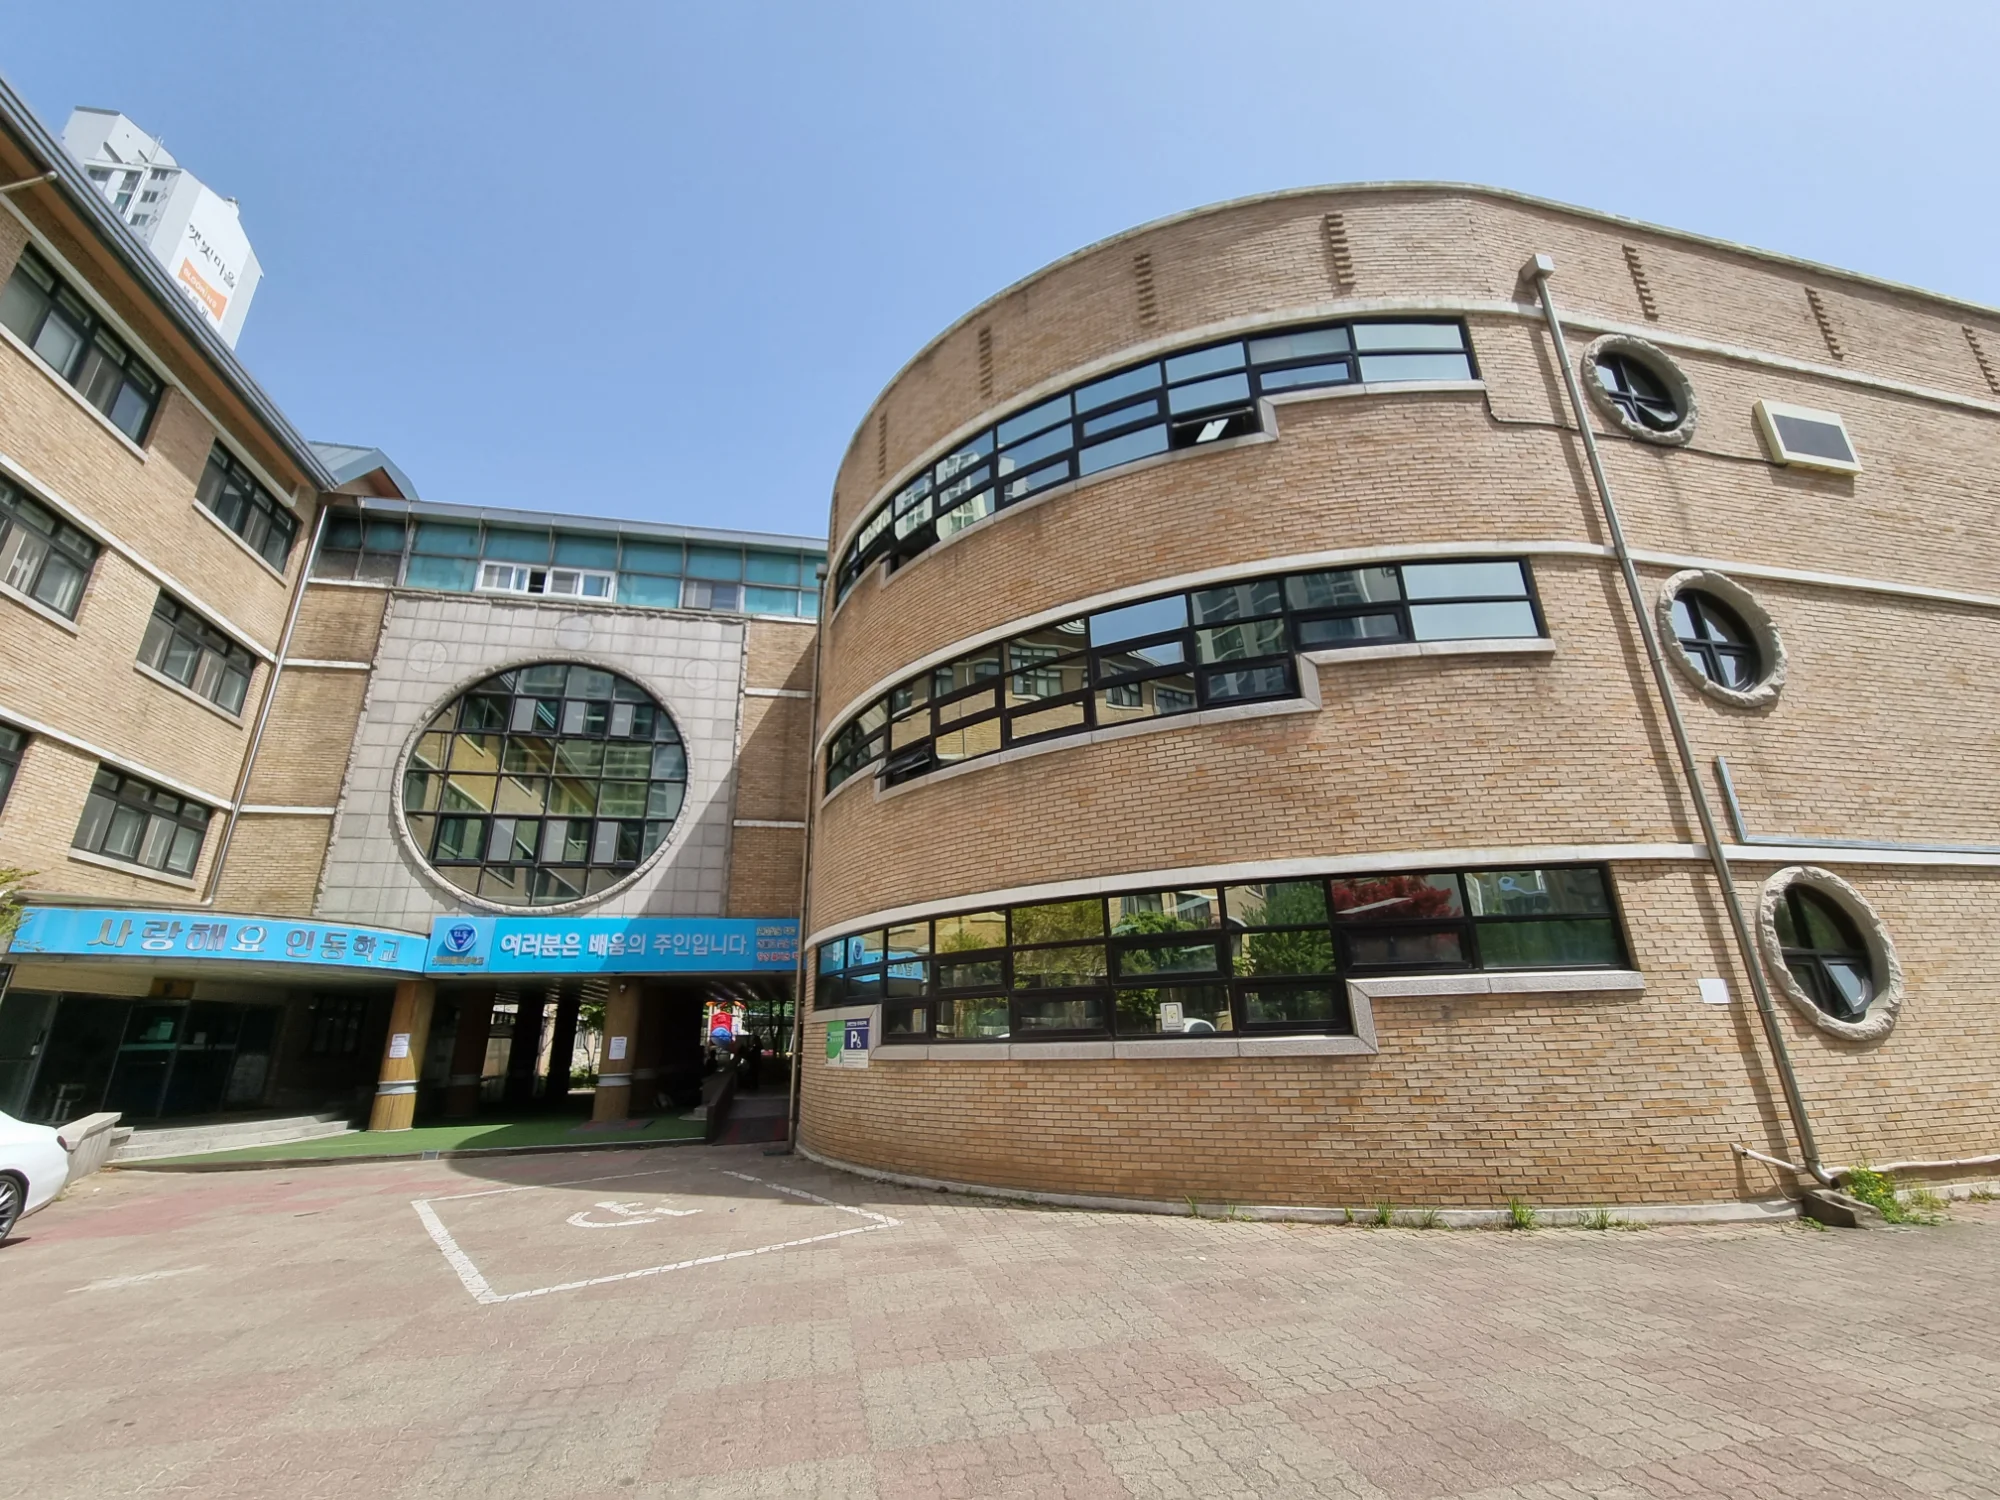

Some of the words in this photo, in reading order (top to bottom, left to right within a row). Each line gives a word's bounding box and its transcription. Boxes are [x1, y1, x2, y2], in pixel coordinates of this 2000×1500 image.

[87, 918, 269, 953] 사랑해요
[285, 928, 400, 963] 인동학교
[500, 932, 582, 957] 여러분은
[588, 932, 646, 957] 배움의
[850, 1031, 858, 1048] P
